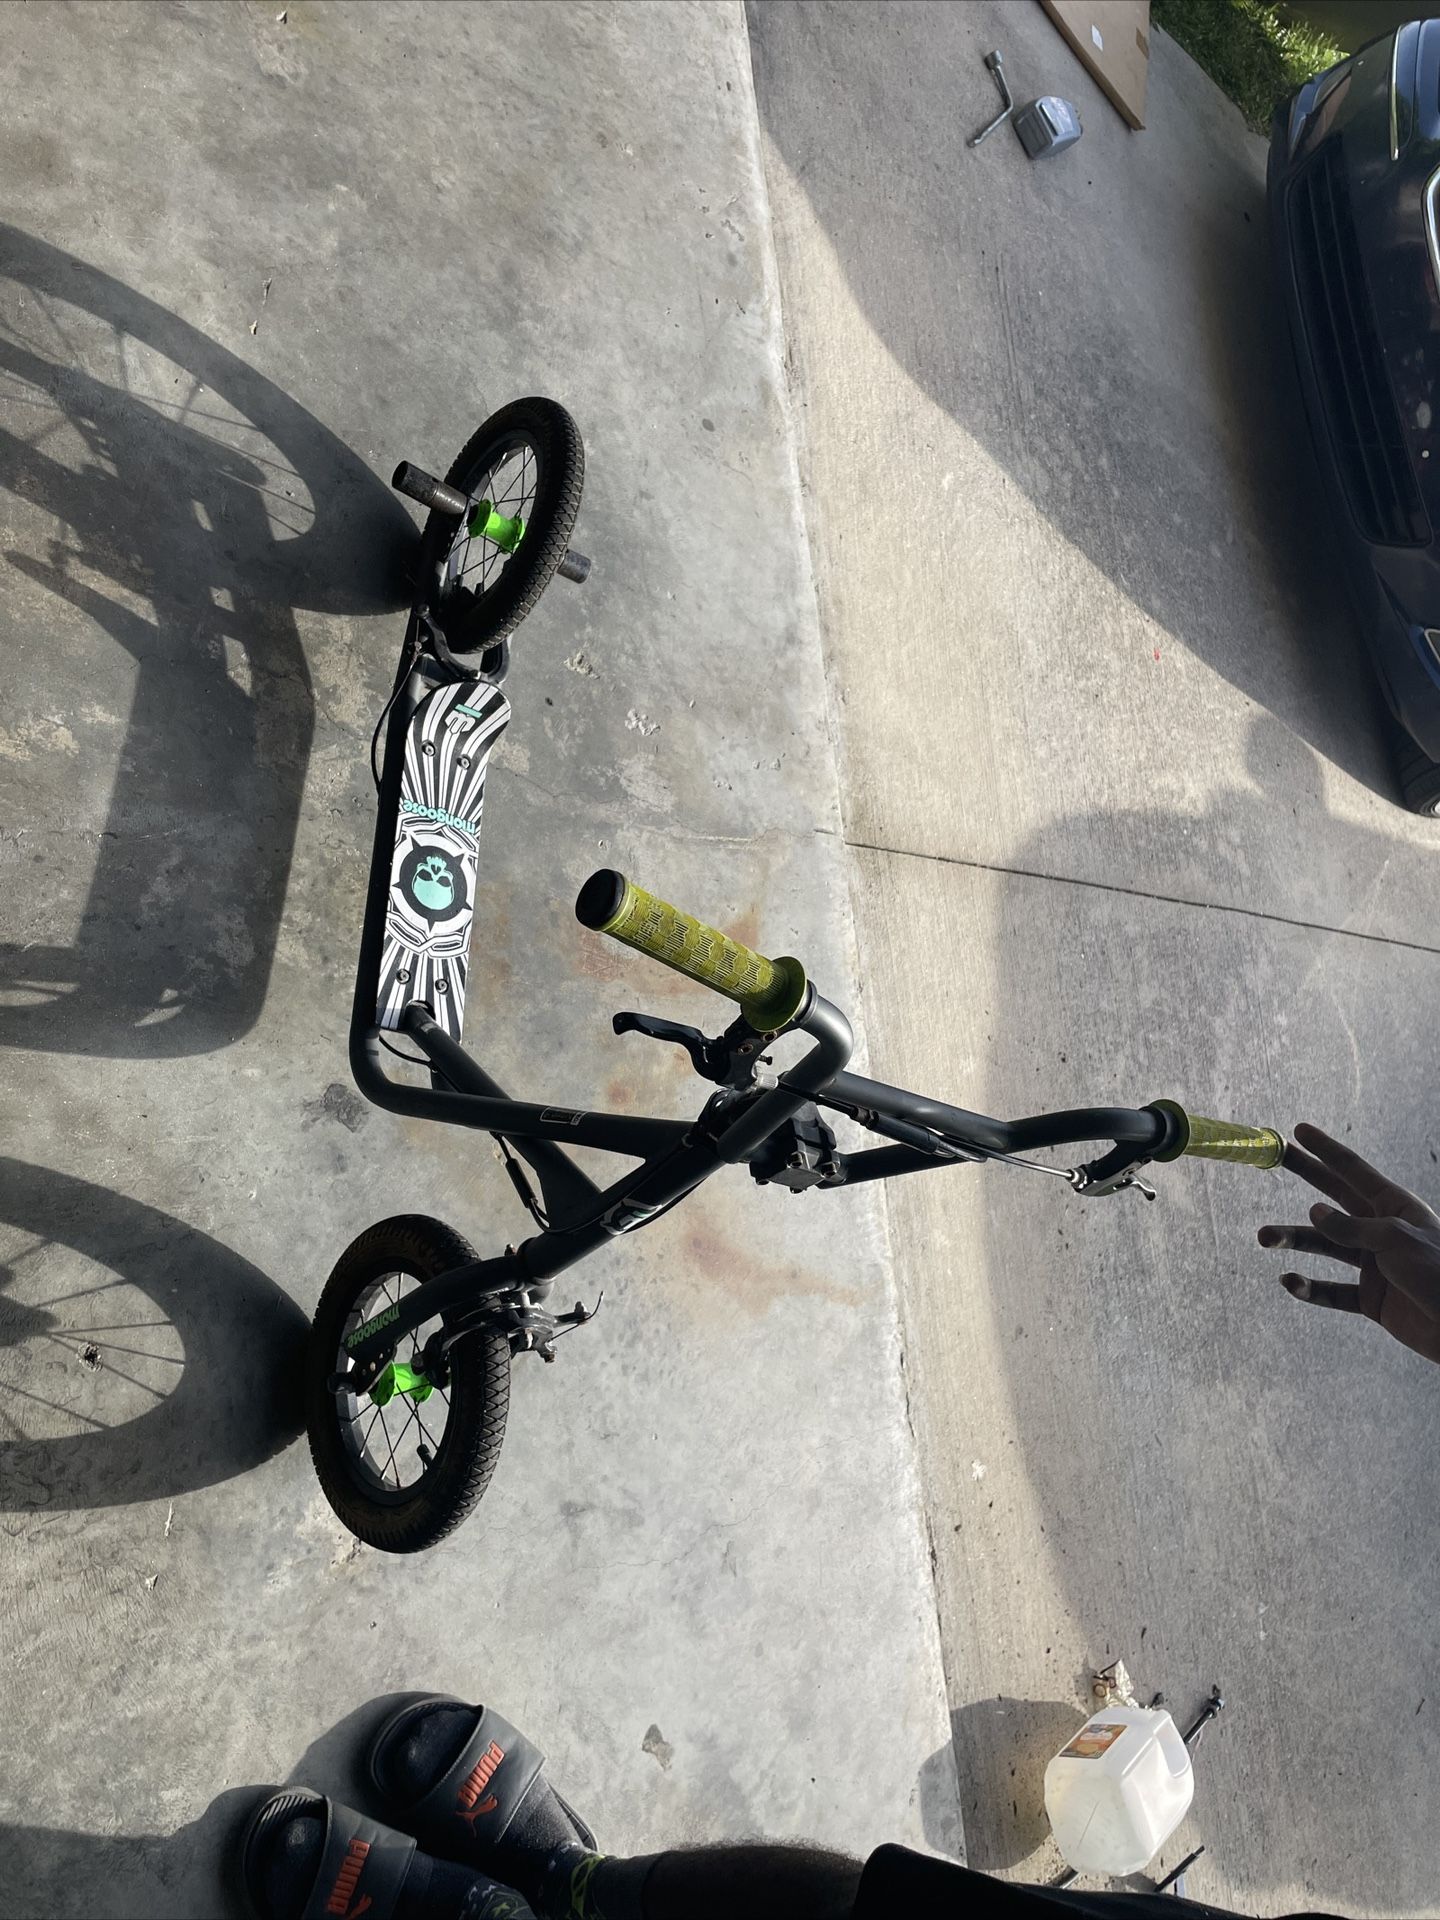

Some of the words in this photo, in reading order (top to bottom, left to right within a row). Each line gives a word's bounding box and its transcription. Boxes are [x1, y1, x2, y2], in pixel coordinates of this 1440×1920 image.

[403, 799, 476, 834] mongoose
[347, 1305, 400, 1348] mongoose
[458, 1740, 504, 1808] PUMA
